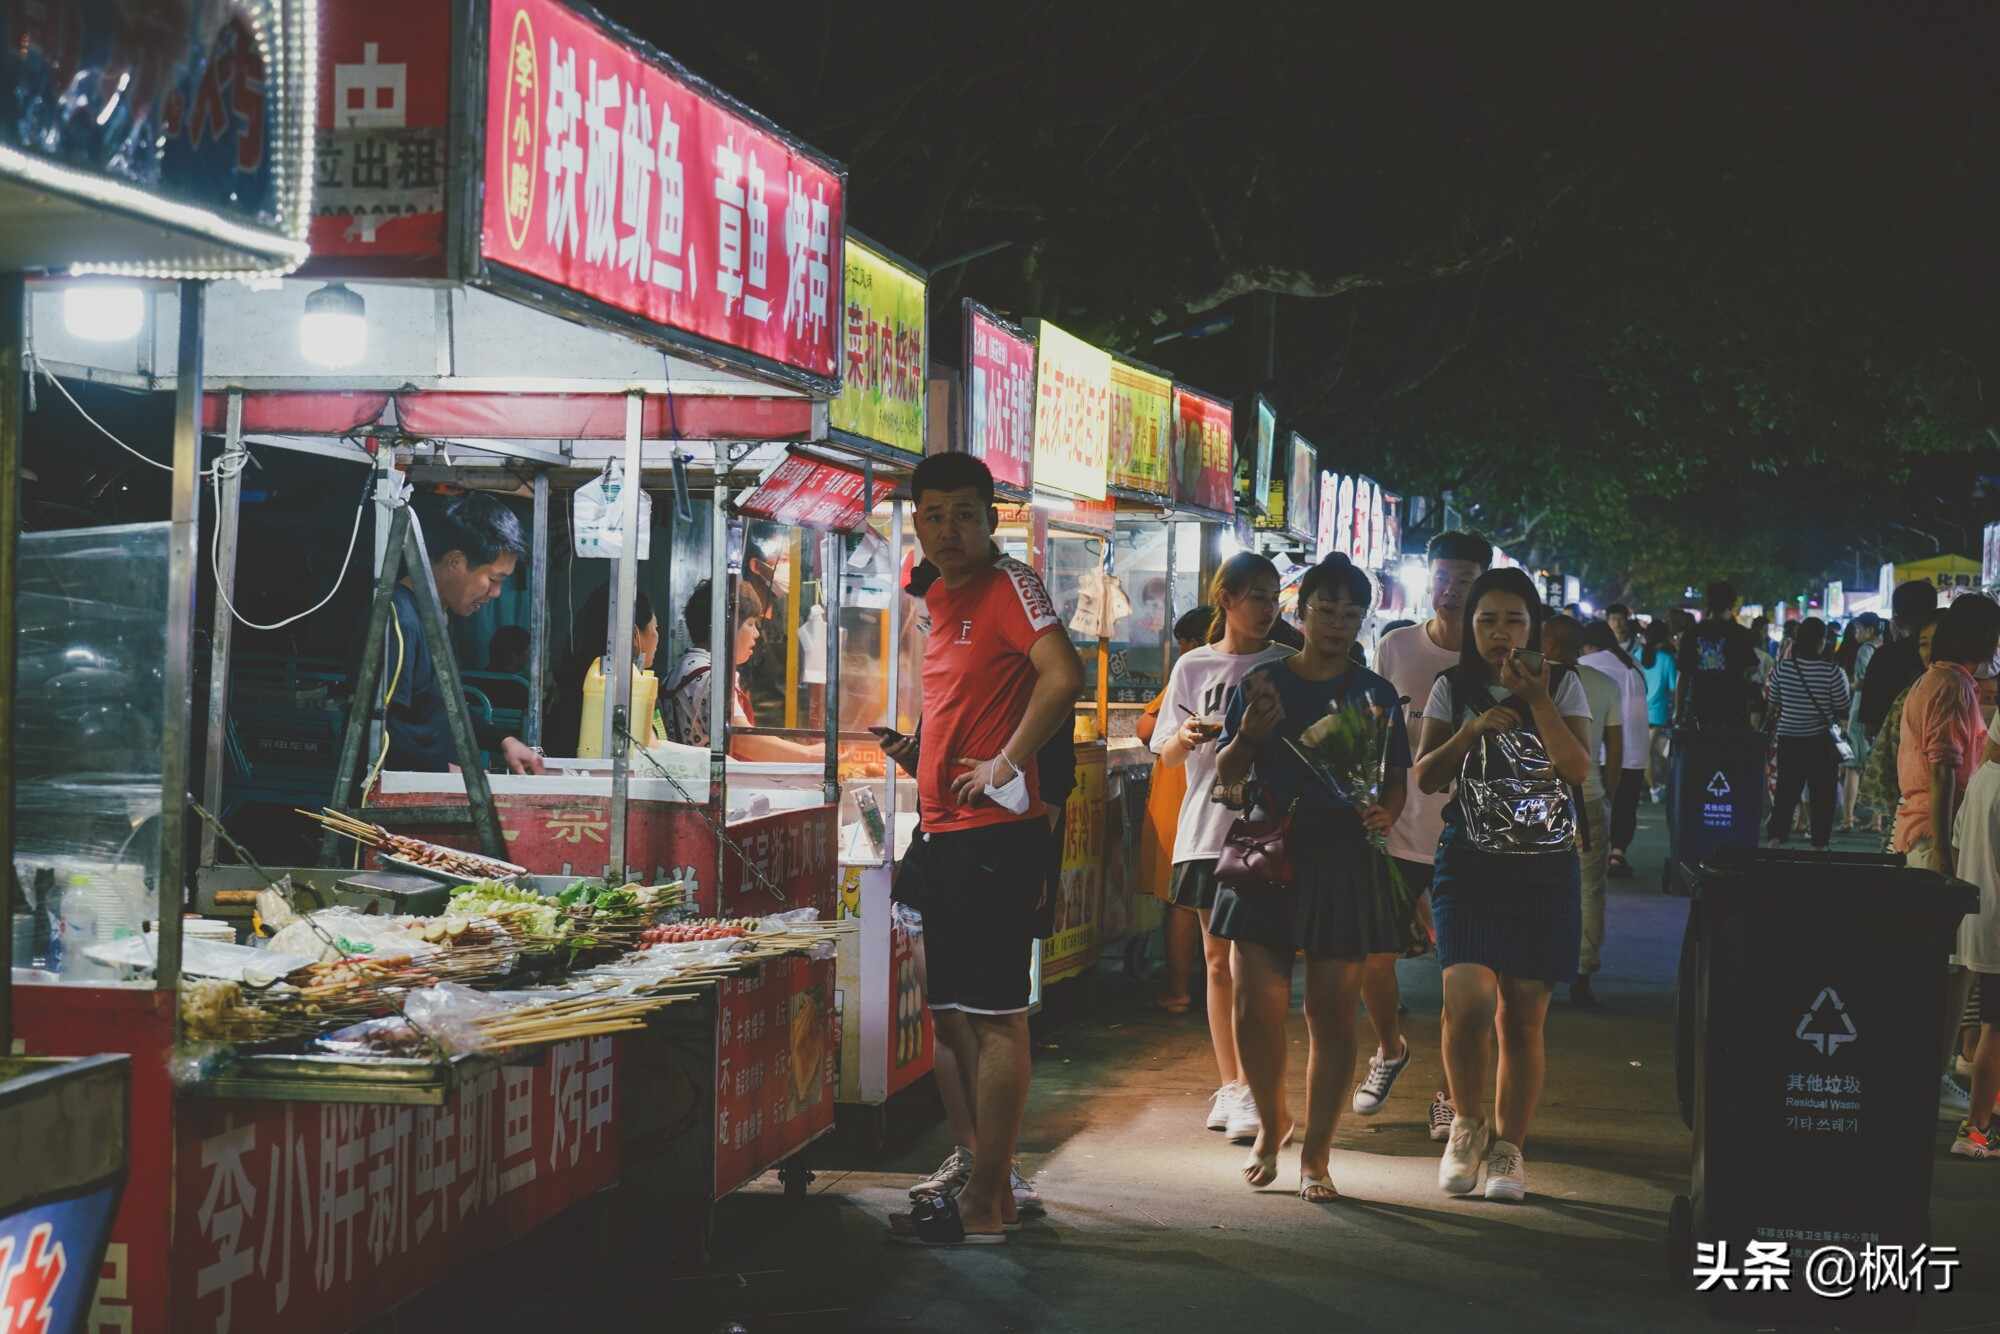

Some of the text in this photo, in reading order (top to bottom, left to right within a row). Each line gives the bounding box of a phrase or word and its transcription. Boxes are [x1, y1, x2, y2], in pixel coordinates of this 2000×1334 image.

[511, 41, 532, 220] 李小胖
[783, 170, 830, 345] 烤串
[1786, 1073, 1862, 1095] 其他垃圾
[1786, 1115, 1859, 1133] 기타 쓰레기
